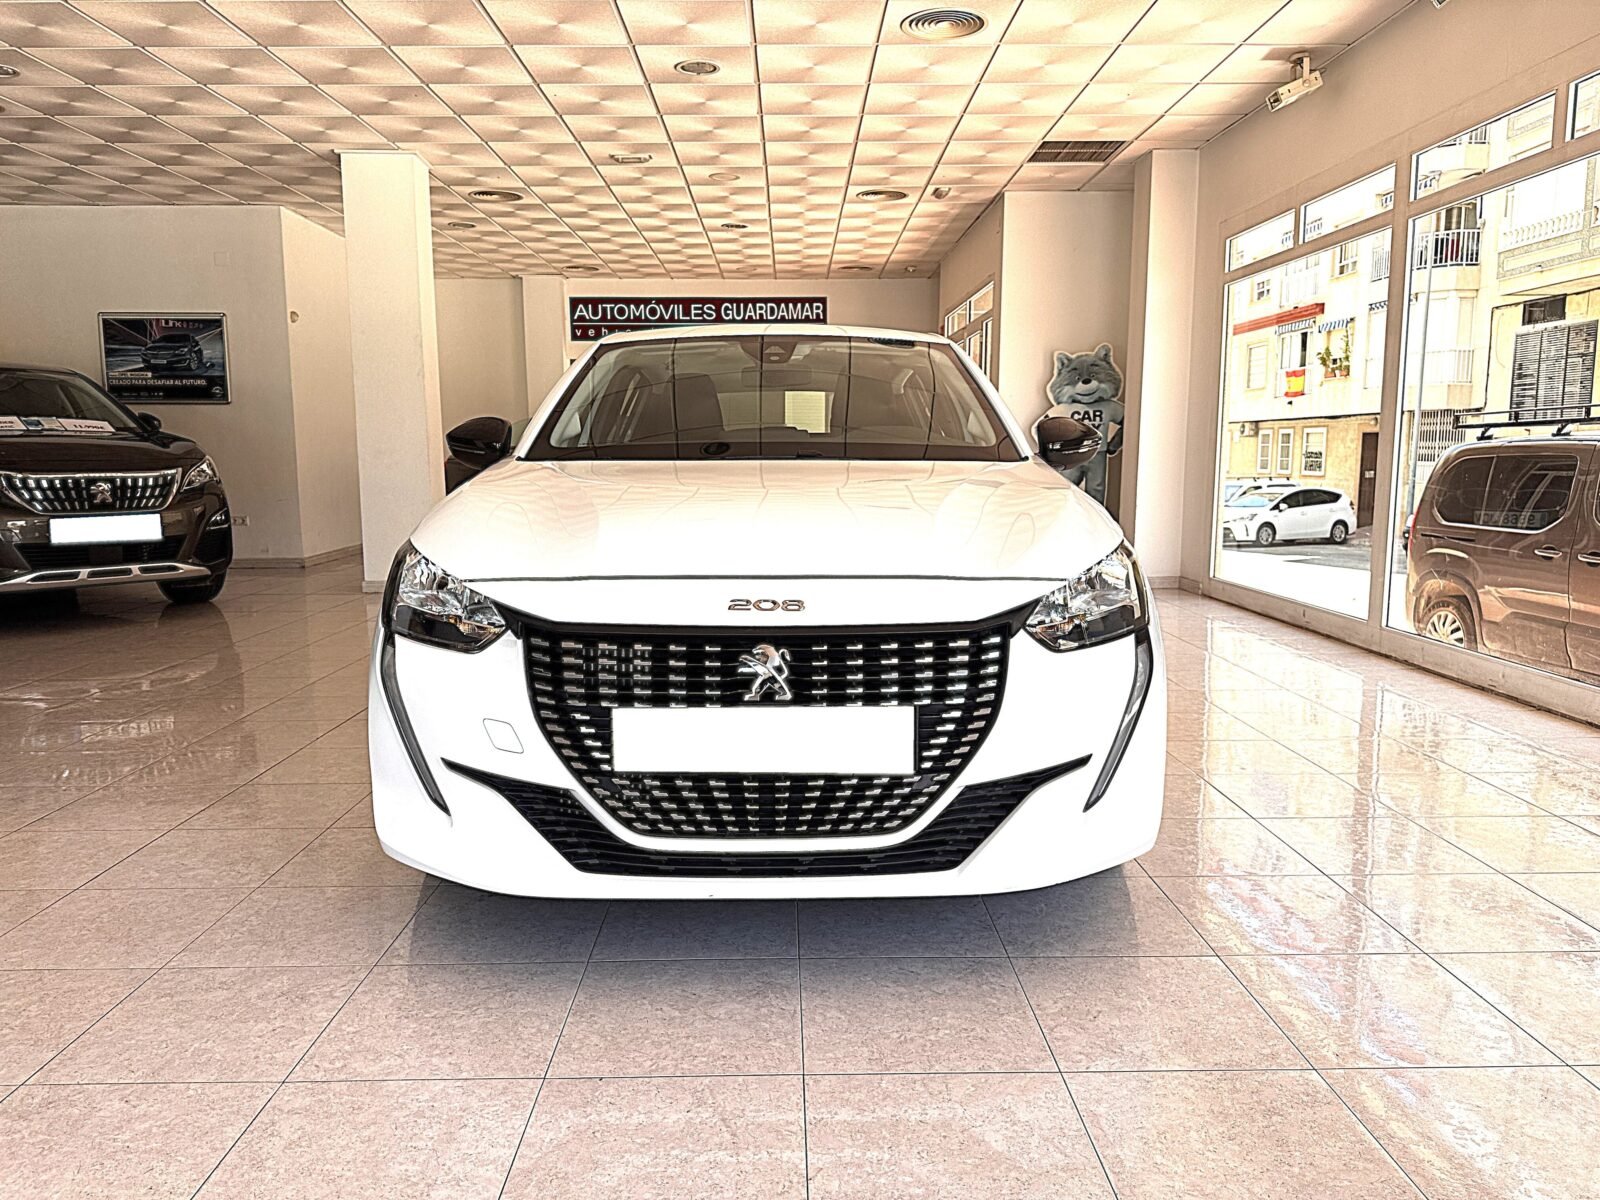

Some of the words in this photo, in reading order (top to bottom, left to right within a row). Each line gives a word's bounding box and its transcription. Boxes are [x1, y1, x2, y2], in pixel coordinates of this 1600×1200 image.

[573, 300, 716, 321] AUTOMÓVILES
[720, 302, 824, 320] GUARDAMAR
[1070, 409, 1104, 423] CAR
[727, 598, 806, 612] 208
